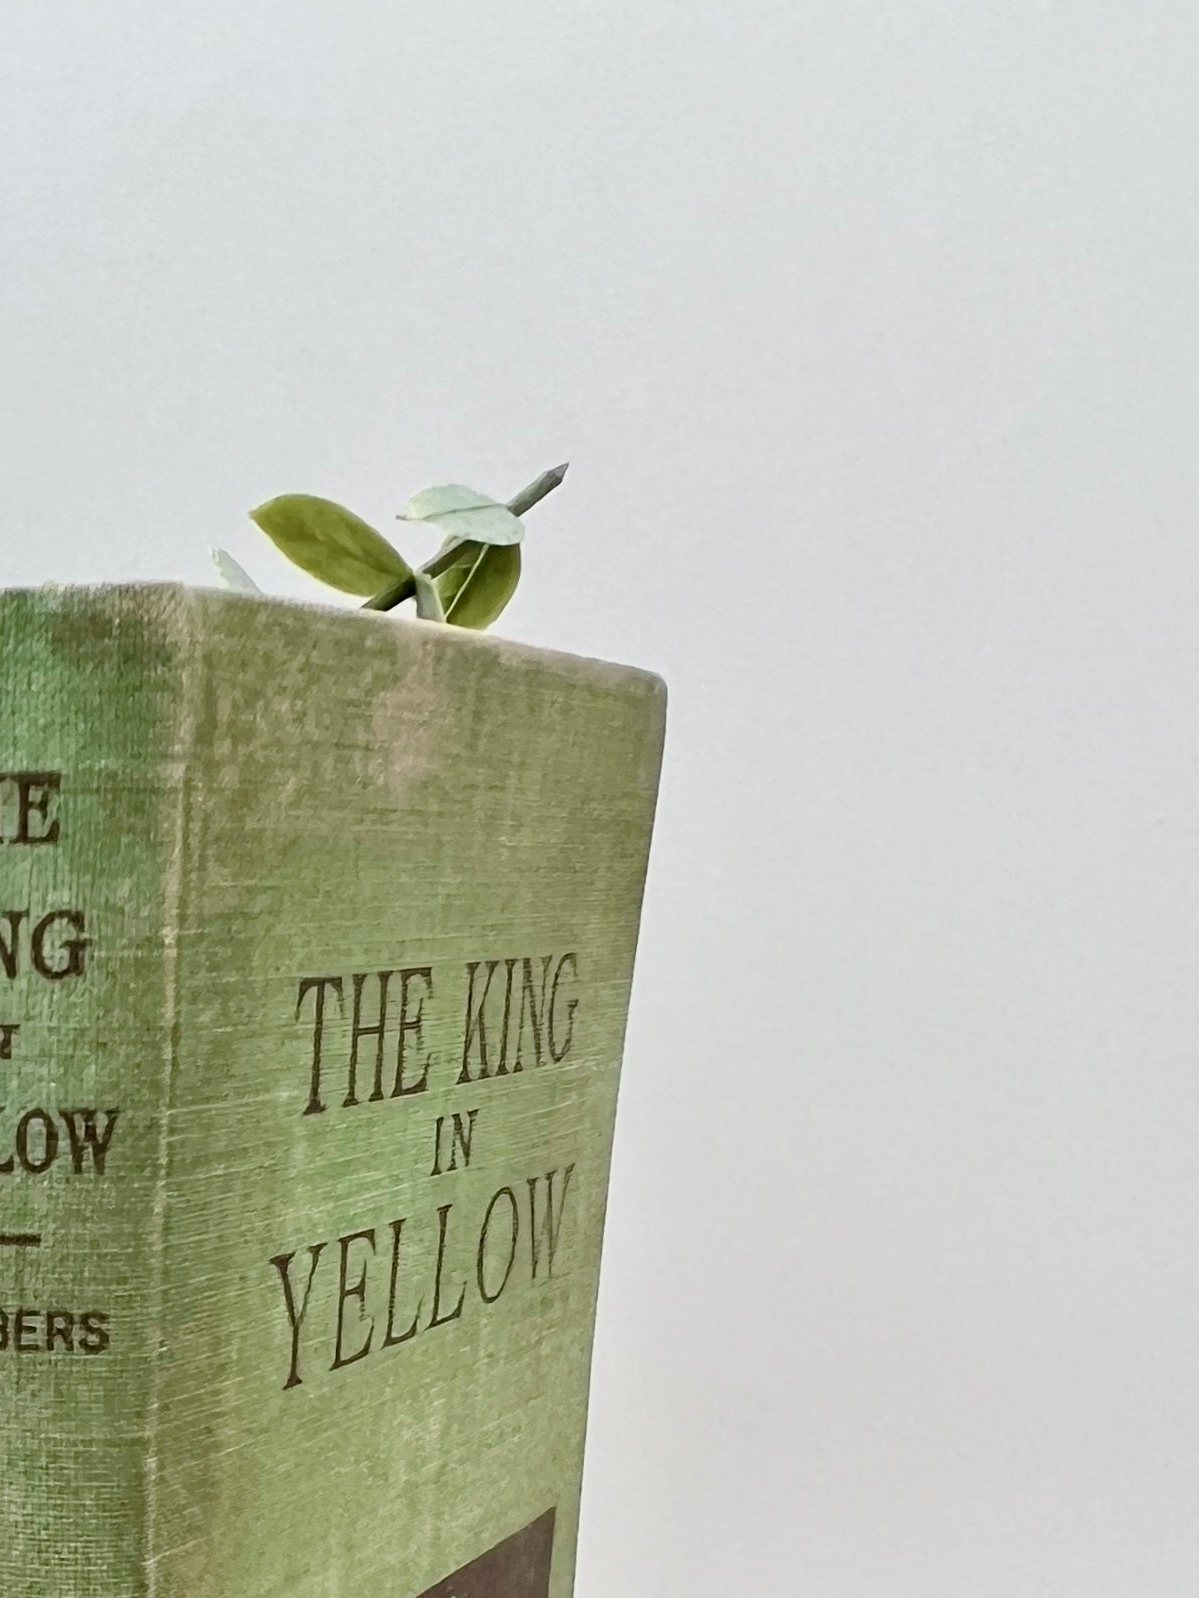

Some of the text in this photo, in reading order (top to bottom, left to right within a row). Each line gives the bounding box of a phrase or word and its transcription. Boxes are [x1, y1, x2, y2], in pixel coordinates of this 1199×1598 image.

[295, 952, 579, 1115] THE KING
[430, 1109, 479, 1176] IN
[269, 1163, 576, 1390] YELLOW
